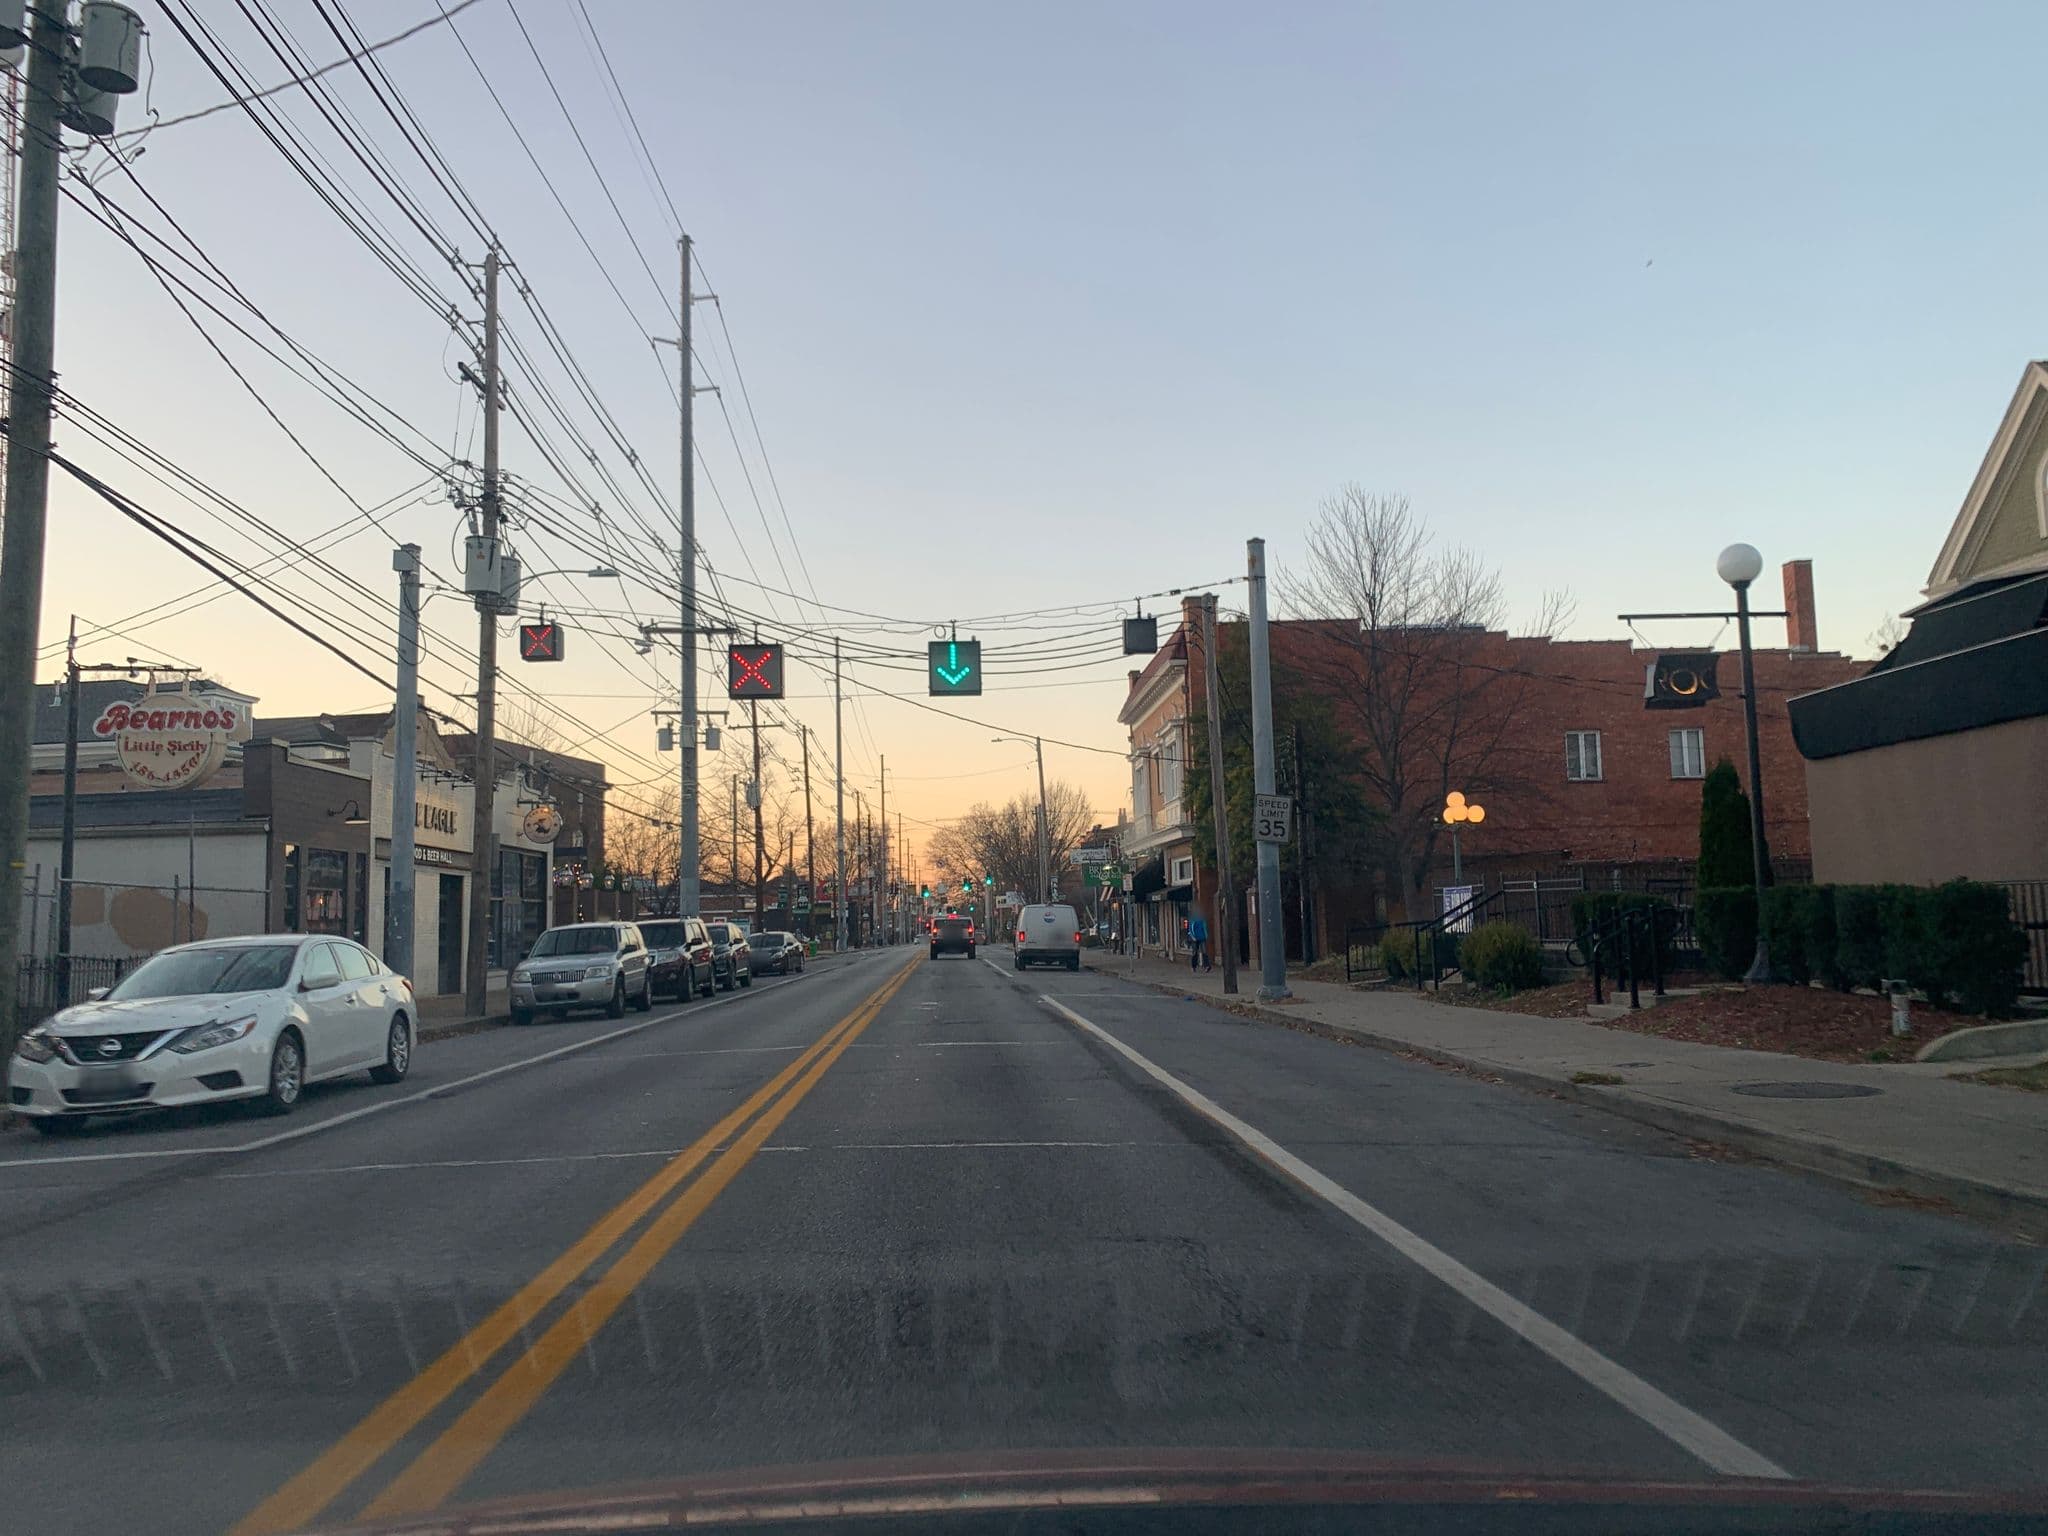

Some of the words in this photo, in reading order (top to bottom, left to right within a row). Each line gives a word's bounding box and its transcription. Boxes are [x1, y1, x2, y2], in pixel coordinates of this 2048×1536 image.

[96, 704, 235, 735] Bearno's
[124, 736, 164, 752] Little
[167, 740, 208, 754] Sicily
[1258, 799, 1289, 809] SPEED
[424, 804, 458, 834] EAGLE
[1261, 809, 1285, 819] LIMIT
[1259, 819, 1286, 837] 35
[427, 849, 440, 862] BEER
[440, 851, 453, 864] HALL
